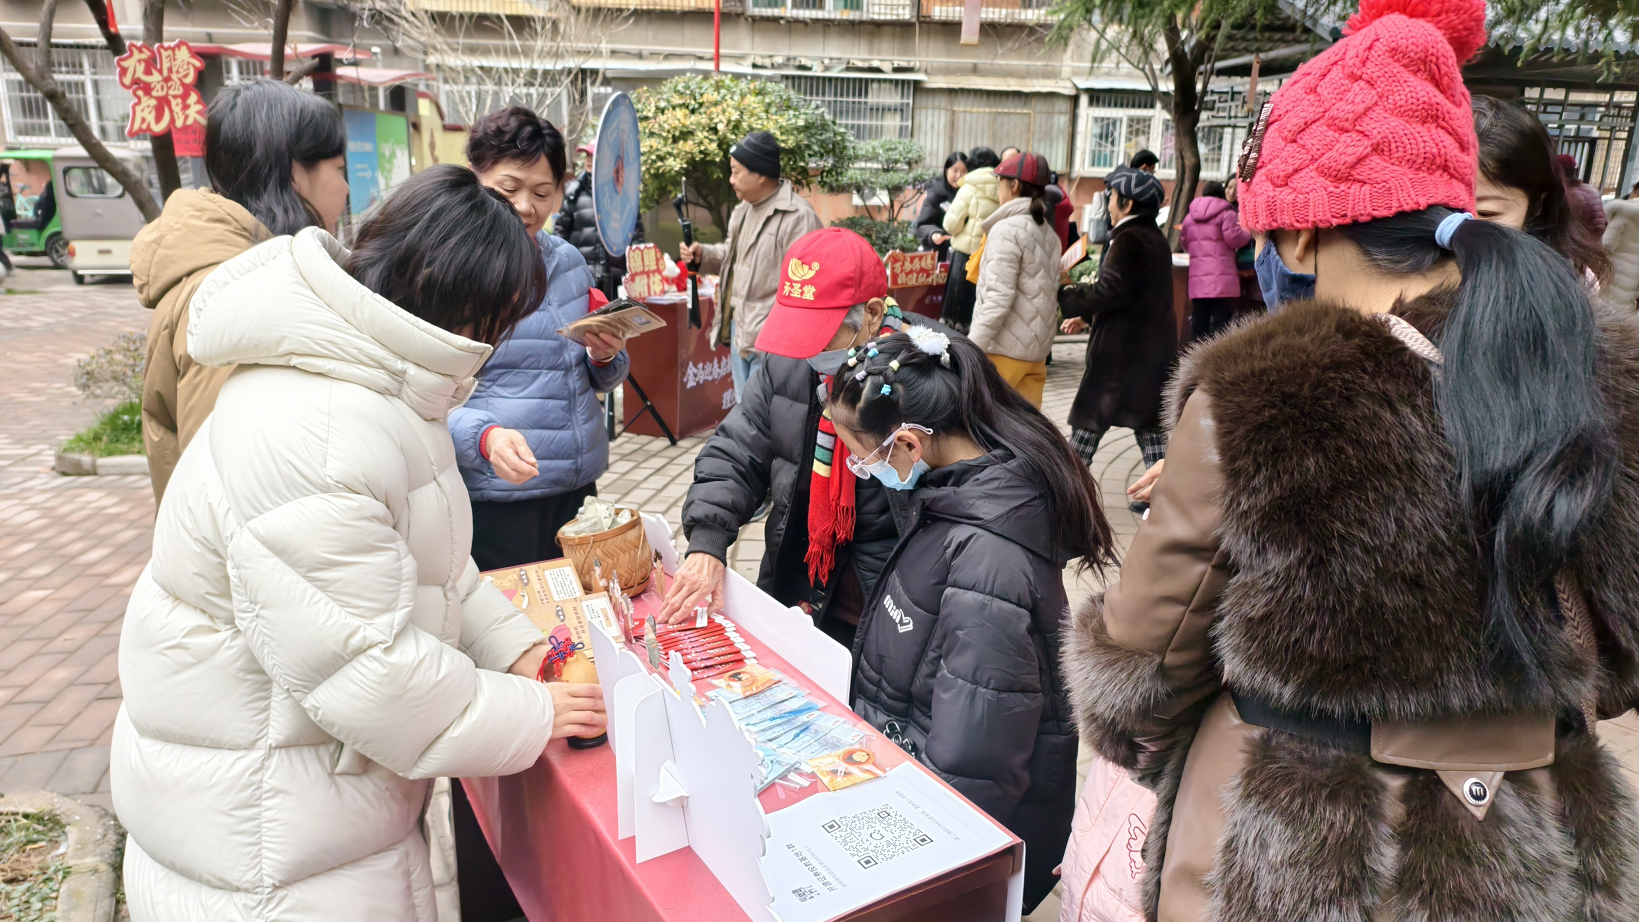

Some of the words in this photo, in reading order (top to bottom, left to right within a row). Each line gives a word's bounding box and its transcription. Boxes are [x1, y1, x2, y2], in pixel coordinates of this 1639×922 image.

[119, 45, 201, 86] 龙腾
[151, 81, 183, 97] 2026
[132, 91, 208, 133] 虎跃
